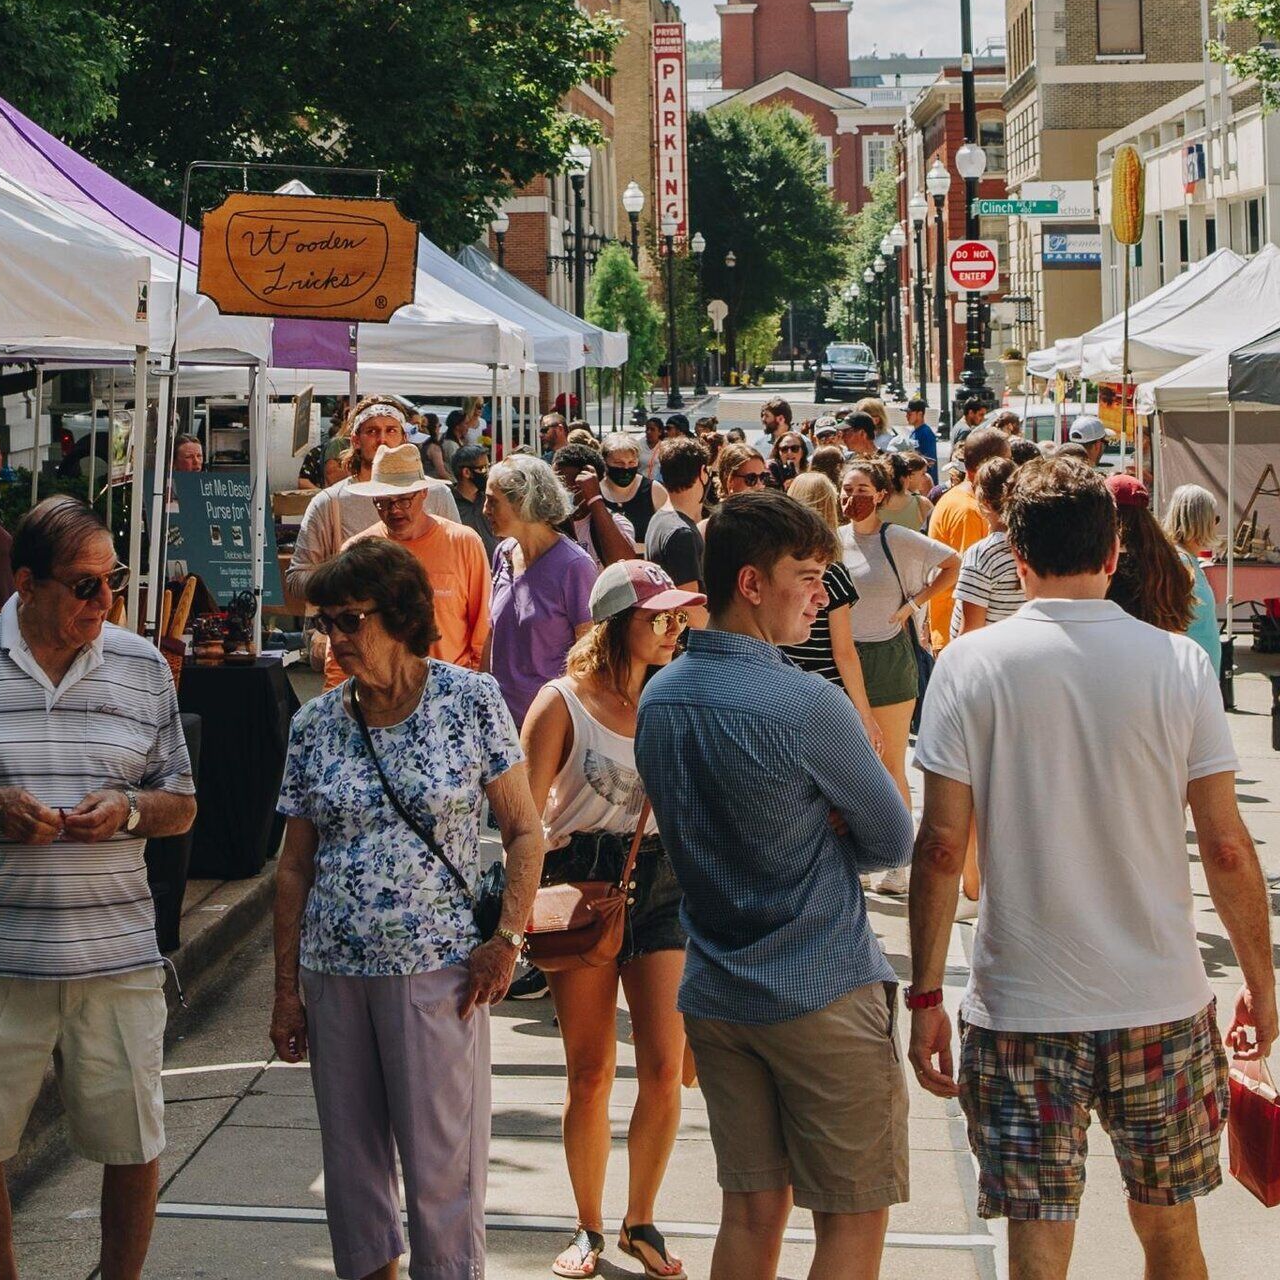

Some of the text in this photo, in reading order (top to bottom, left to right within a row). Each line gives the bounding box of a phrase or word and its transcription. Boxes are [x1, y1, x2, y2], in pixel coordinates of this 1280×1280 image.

[663, 64, 679, 220] PARKING
[981, 200, 1014, 214] Clinch
[242, 225, 367, 256] Wooden
[956, 250, 989, 259] DO NOT
[959, 272, 986, 281] ENTER
[200, 480, 252, 500] Let Me Desig
[206, 501, 231, 519] Purse
[231, 503, 244, 521] for
